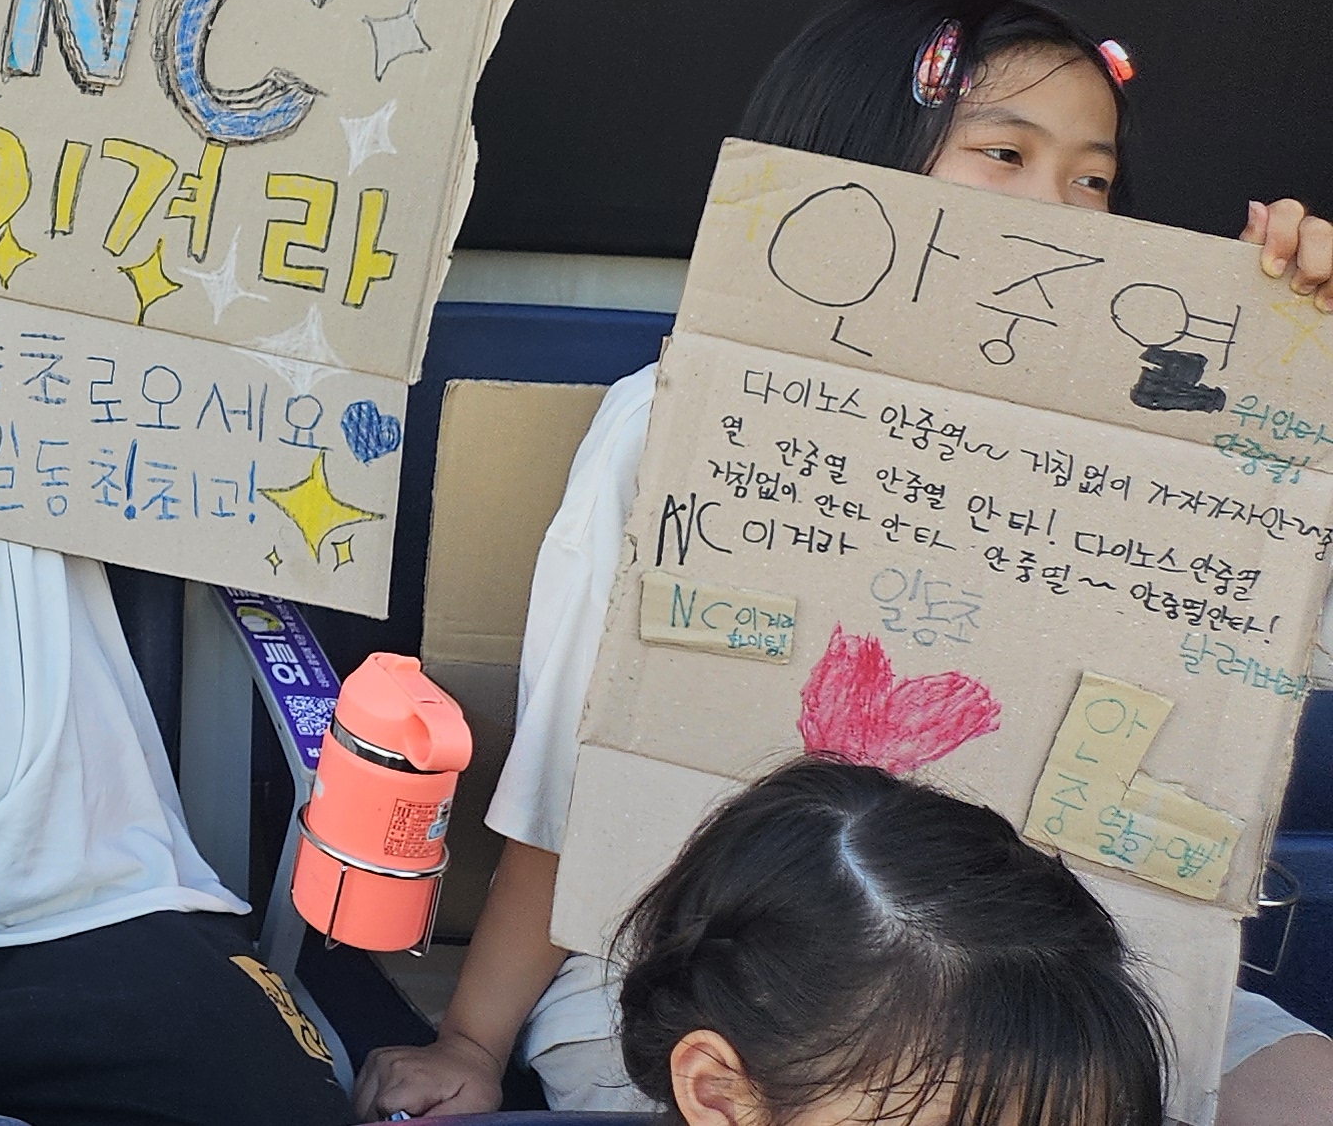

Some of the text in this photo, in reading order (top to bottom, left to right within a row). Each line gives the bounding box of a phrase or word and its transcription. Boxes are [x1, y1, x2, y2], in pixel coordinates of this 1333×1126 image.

[744, 369, 867, 419] 다이노스
[1021, 449, 1131, 501] 거침없이
[655, 492, 859, 566] NC 이겨라
[721, 415, 745, 447] 열
[776, 437, 848, 484] 안중열
[876, 466, 946, 510] 안중열
[1074, 531, 1188, 574] 다이노스
[1190, 554, 1261, 601] 안중열
[814, 494, 871, 522] 안타
[881, 513, 957, 551] 안타
[670, 584, 732, 629] NC
[872, 569, 982, 646] 일동초
